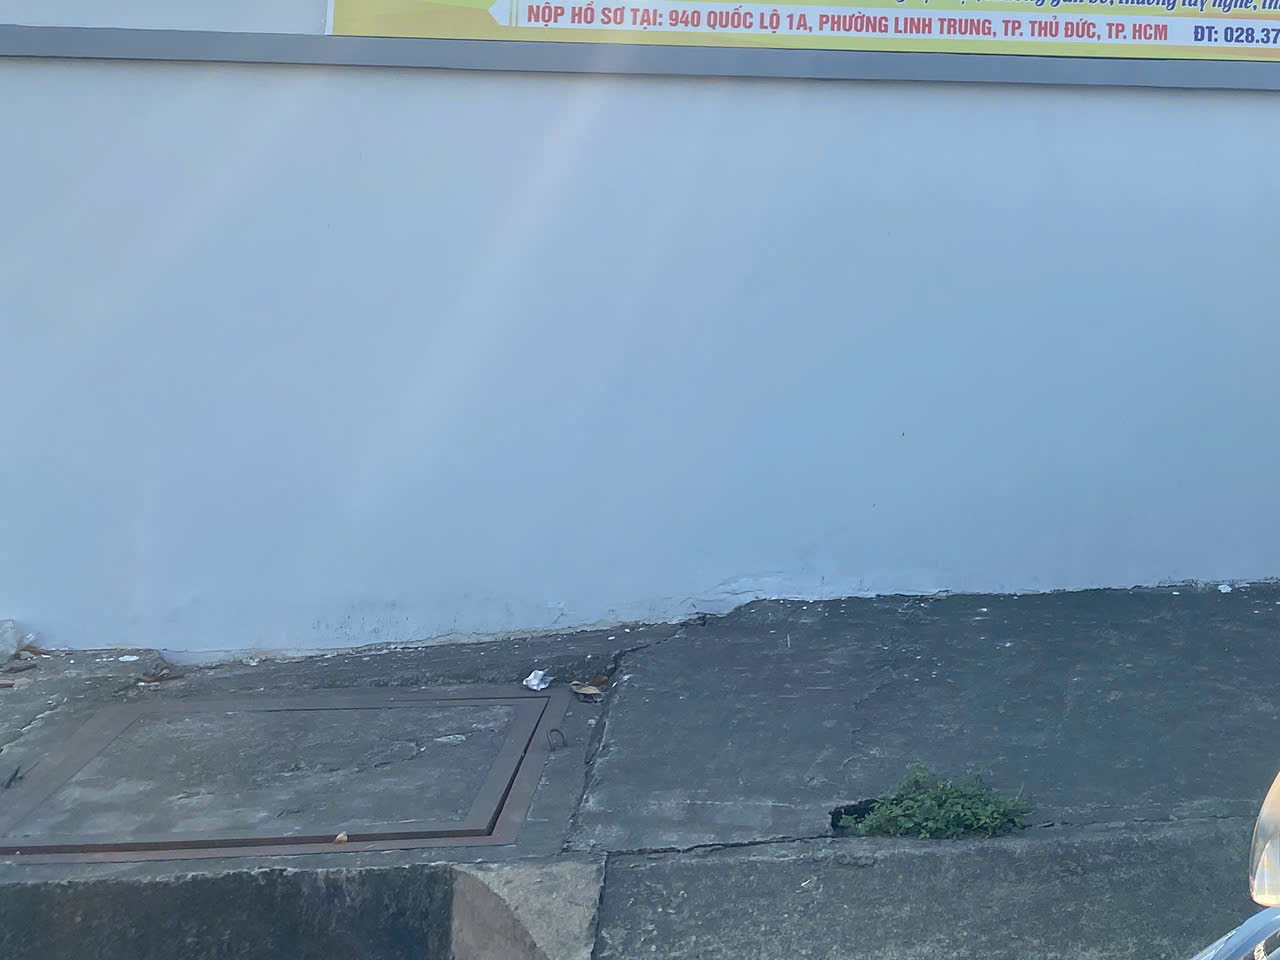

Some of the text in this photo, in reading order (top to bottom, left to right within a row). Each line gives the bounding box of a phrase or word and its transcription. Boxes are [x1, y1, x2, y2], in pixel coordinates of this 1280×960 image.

[527, 0, 1168, 40] NỘP HỒ SƠ TẠI: 940 QUỐC LỘ 1A, PHƯỜNG LINH TRUNG, TP. THỦ ĐỨC, TP. HCM
[1193, 24, 1218, 42] ĐT:
